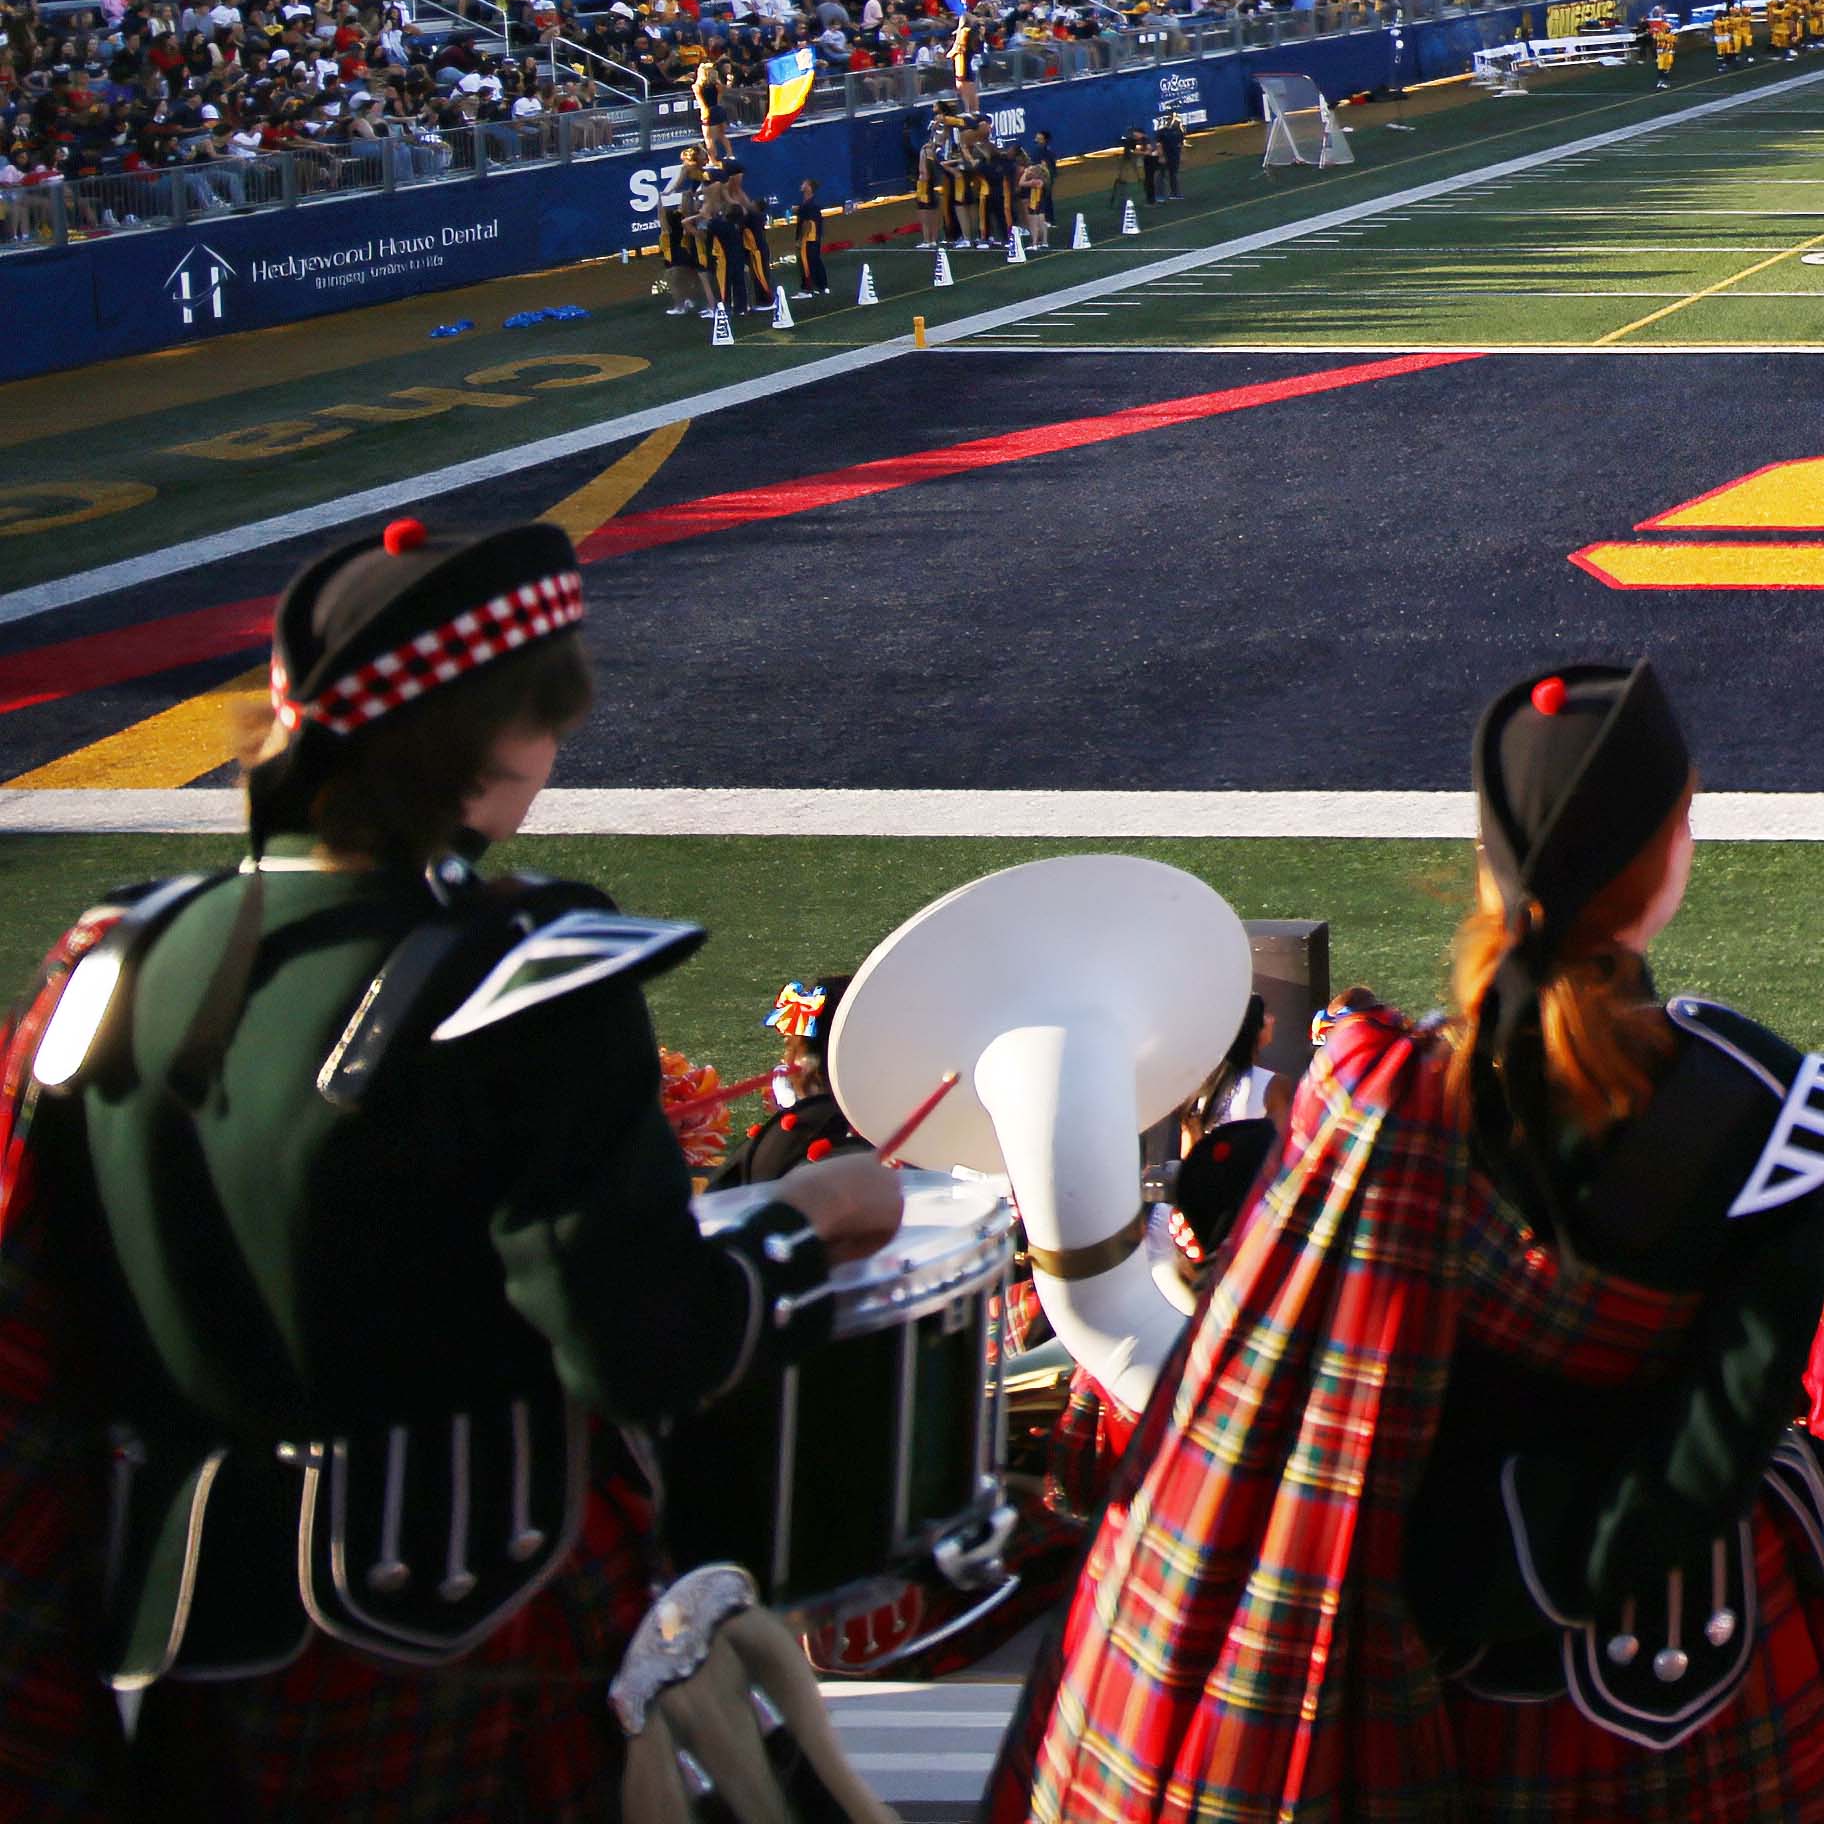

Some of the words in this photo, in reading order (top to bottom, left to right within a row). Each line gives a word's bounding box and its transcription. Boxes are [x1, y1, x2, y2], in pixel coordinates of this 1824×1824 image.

[252, 241, 373, 283] Hedgewood
[379, 236, 436, 257] House
[442, 219, 499, 247] Dental
